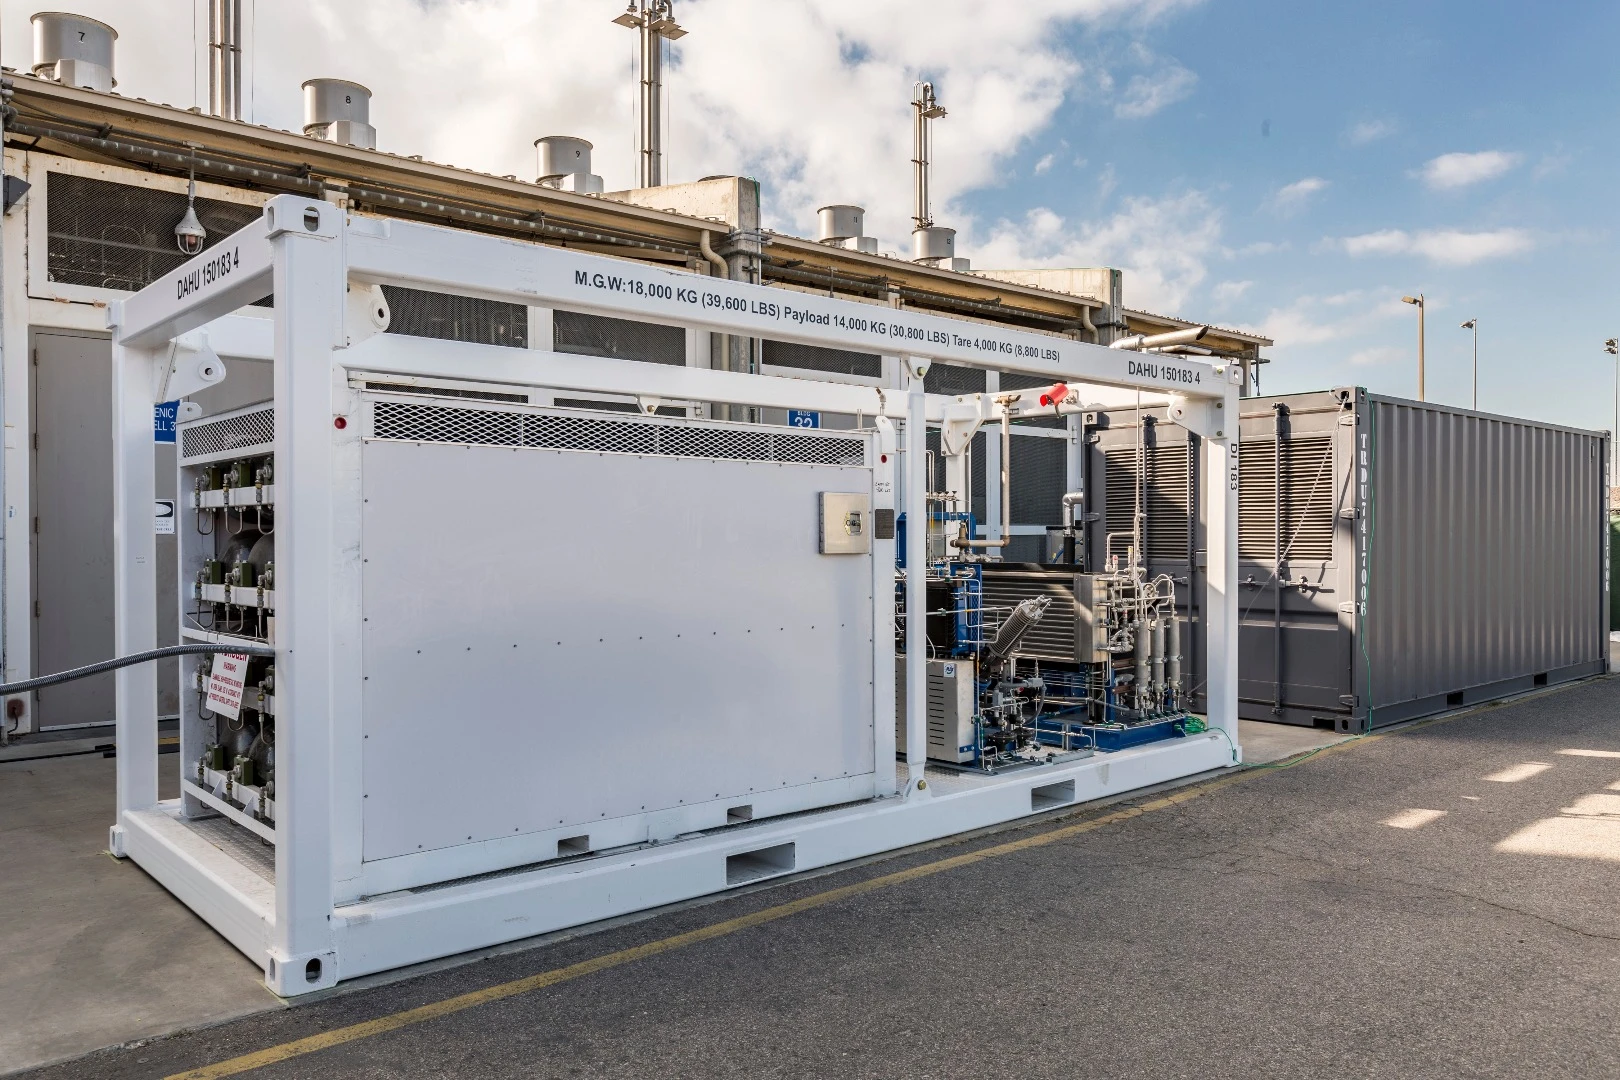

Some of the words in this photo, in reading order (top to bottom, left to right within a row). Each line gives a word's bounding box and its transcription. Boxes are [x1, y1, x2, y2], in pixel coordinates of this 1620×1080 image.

[78, 31, 85, 42] 7
[345, 95, 352, 104] 8
[575, 150, 581, 158] 9
[177, 269, 200, 301] DAHU
[203, 252, 231, 286] 150183
[233, 246, 239, 269] 4
[575, 270, 672, 299] M.G.W:18,000
[676, 287, 698, 303] KG
[701, 292, 747, 312] (39,600
[751, 301, 780, 320] LBS)
[784, 306, 830, 326] Payload
[833, 314, 867, 332] 14,000
[870, 320, 886, 335] KG
[889, 323, 924, 341] (30,800
[927, 329, 950, 347] LBS)
[952, 334, 972, 349] Tare
[974, 338, 997, 352] 4,000
[999, 341, 1013, 355] KG
[1014, 343, 1039, 359] (8,800
[1041, 348, 1060, 363] LBS)
[1128, 360, 1158, 379] DAHU
[1160, 366, 1193, 384] 150183
[1194, 371, 1201, 385] 4
[794, 416, 813, 428] 32
[1230, 443, 1238, 459] DI
[1230, 465, 1238, 491] 183
